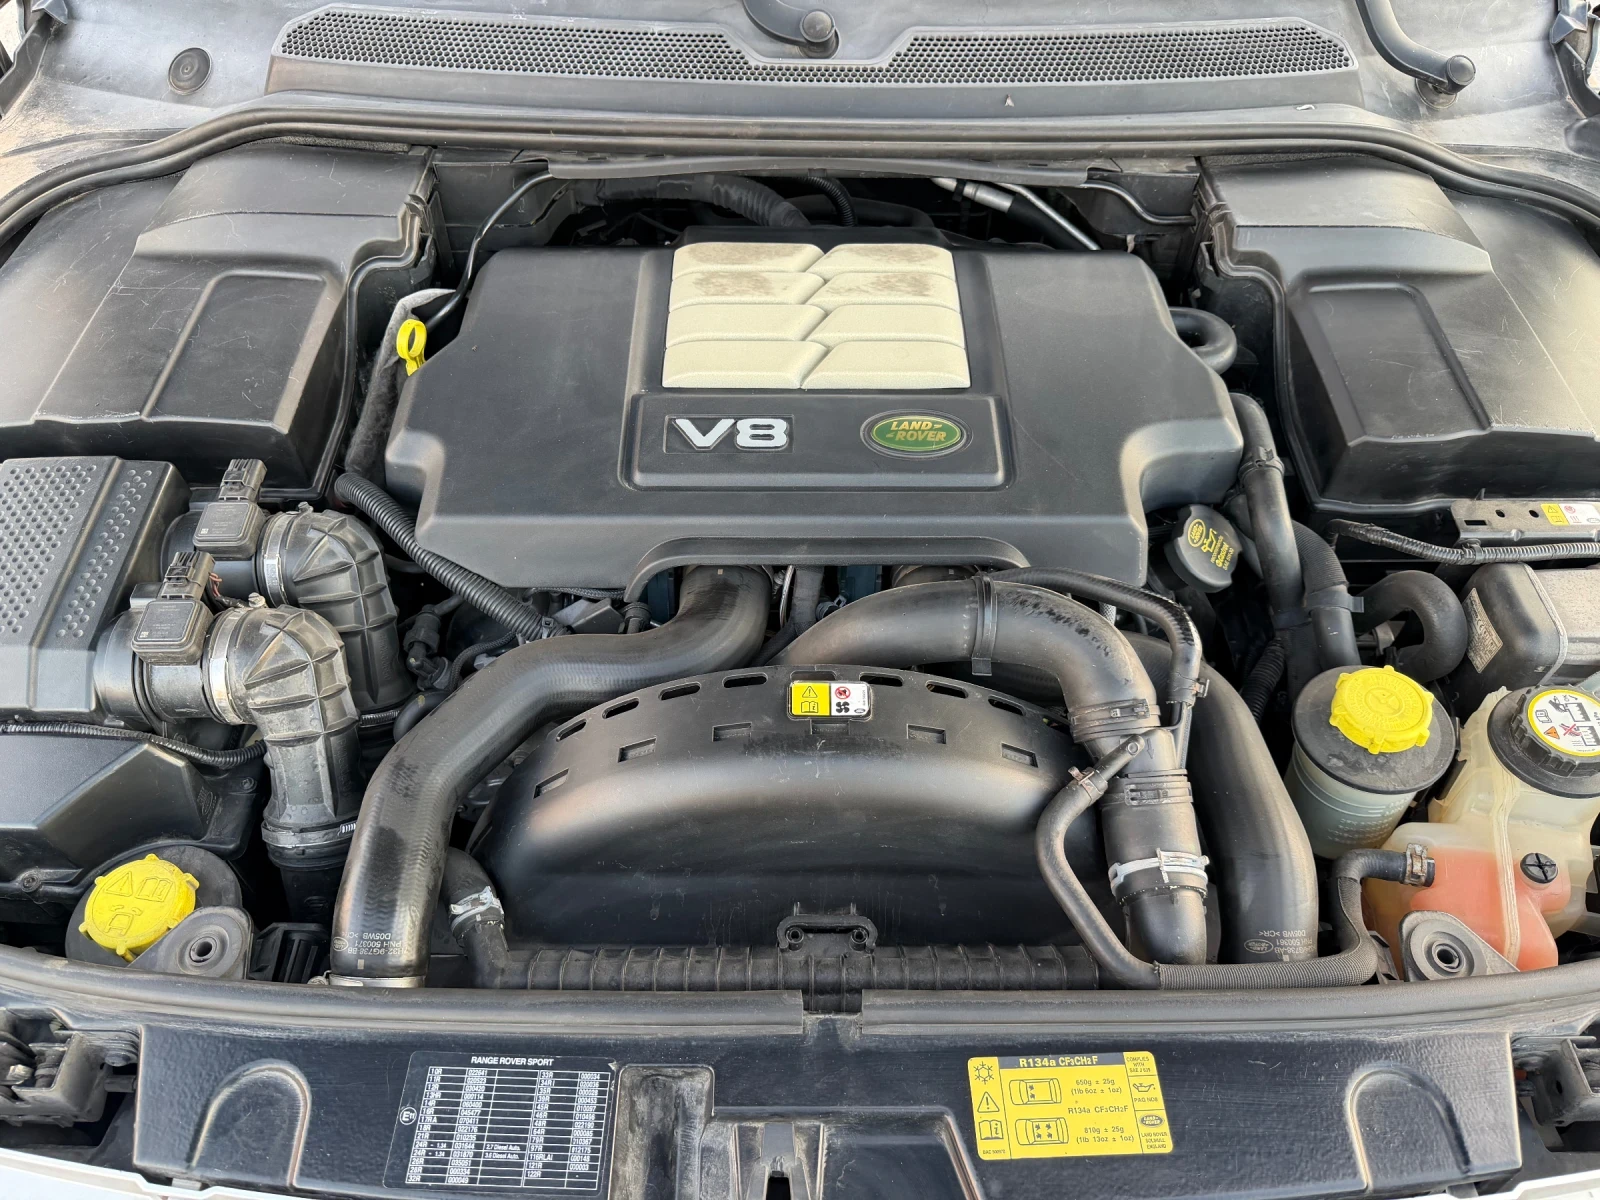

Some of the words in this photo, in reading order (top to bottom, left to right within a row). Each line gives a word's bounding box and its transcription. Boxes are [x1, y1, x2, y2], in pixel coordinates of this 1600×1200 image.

[891, 421, 932, 430] LAND
[674, 418, 788, 448] V8
[895, 431, 946, 441] ROVER
[471, 1056, 498, 1065] RANGE
[499, 1057, 527, 1066] ROVER
[527, 1058, 554, 1066] SPORT
[1019, 1058, 1056, 1068] R134a
[1102, 1078, 1115, 1086] 25g
[1108, 1087, 1122, 1095] 1oz)
[1120, 1135, 1134, 1143] 1oz)
